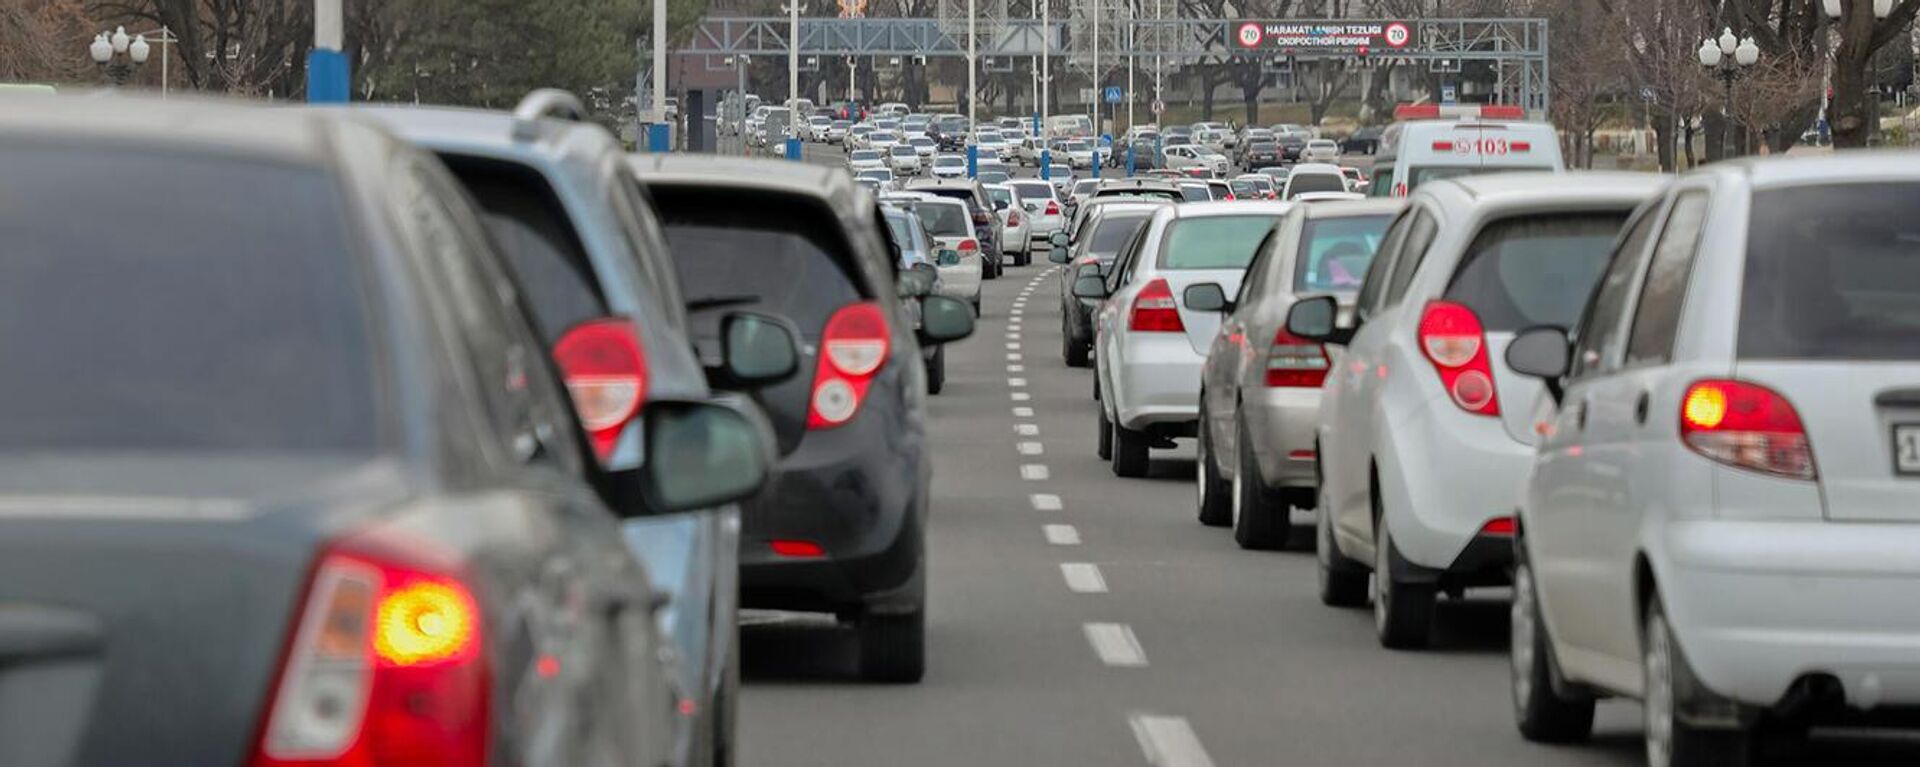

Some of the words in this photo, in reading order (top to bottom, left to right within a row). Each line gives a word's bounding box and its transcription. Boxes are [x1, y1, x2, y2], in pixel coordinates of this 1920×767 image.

[1244, 29, 1257, 39] 70
[1265, 25, 1344, 34] HARAKATLANISH
[1346, 25, 1382, 34] TEZLIGI
[1391, 29, 1403, 39] 70
[1277, 36, 1335, 45] СКОРОСТНОЙ
[1475, 138, 1507, 155] 103
